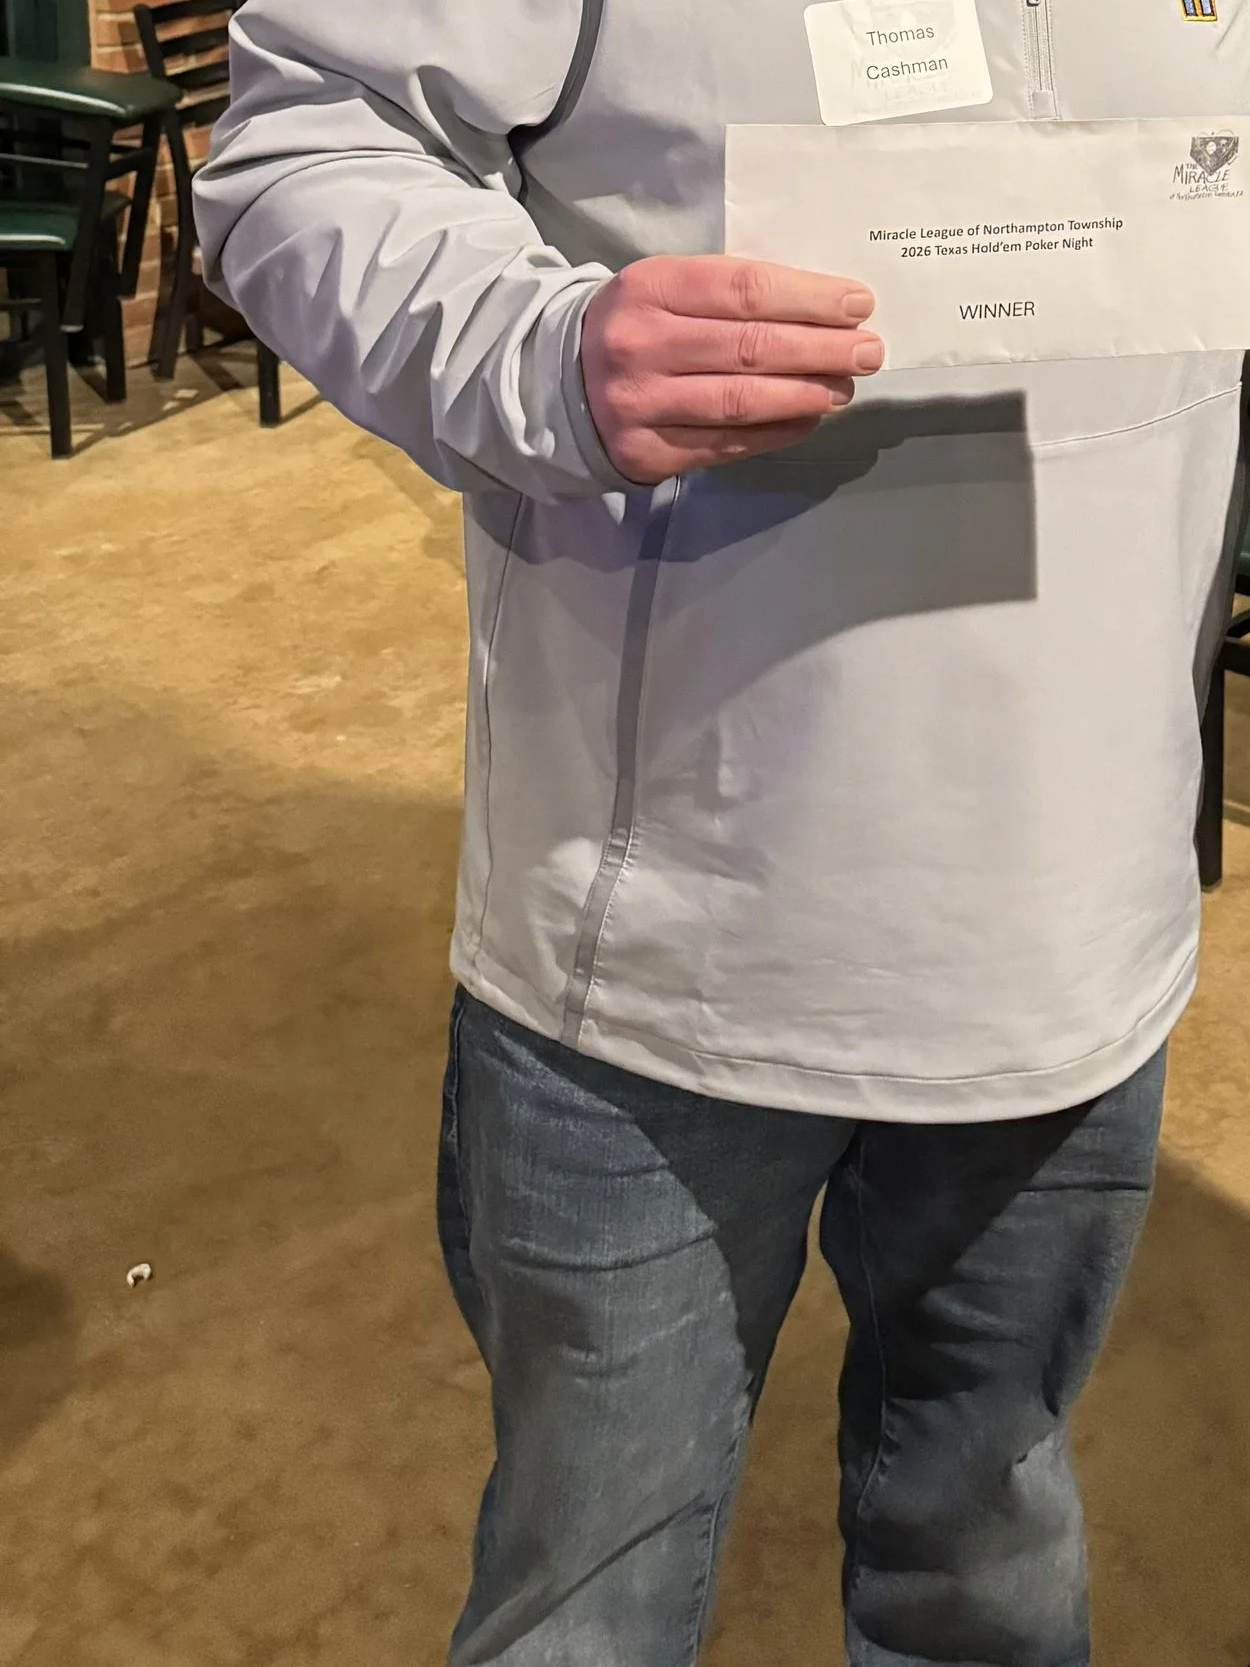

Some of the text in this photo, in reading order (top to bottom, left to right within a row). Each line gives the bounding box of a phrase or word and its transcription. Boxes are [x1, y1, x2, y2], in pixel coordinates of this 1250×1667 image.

[866, 26, 935, 46] Thomas
[866, 58, 948, 80] Cashman
[869, 217, 1123, 241] Miracle League of Northampton Township
[901, 245, 931, 258] 2026
[935, 244, 968, 256] Texas
[1025, 239, 1060, 251] Poker
[1062, 236, 1094, 250] Night
[959, 301, 1036, 320] WINNER
